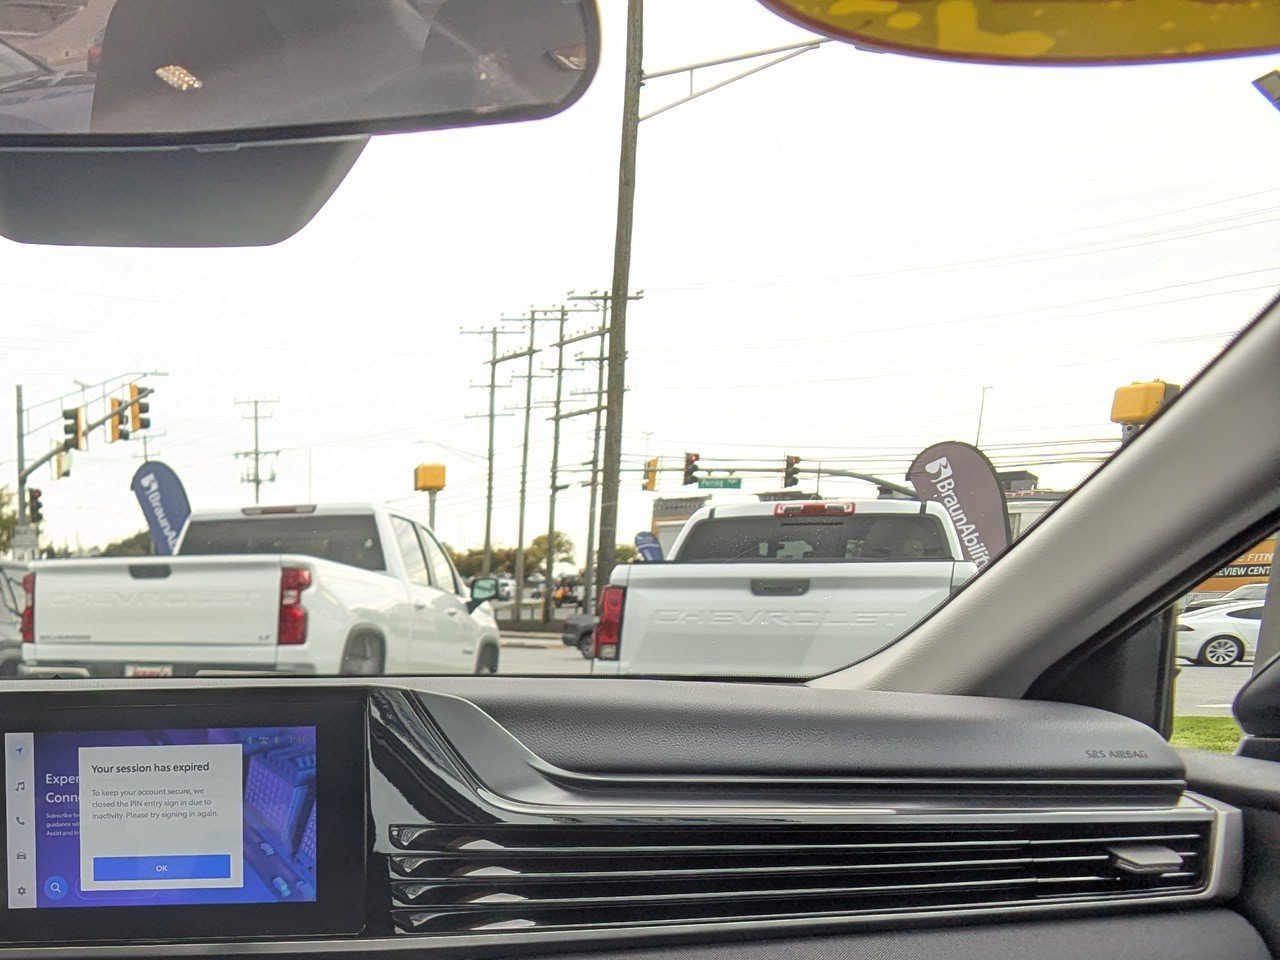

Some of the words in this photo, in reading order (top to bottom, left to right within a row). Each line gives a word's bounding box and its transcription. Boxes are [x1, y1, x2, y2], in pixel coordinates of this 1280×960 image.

[49, 591, 263, 608] CHEVROLET
[653, 608, 908, 627] CHEVROLET
[1085, 749, 1107, 759] SRS
[1109, 750, 1148, 759] AIRBAG
[91, 764, 114, 774] Your
[116, 763, 152, 773] session
[154, 762, 171, 772] has
[173, 761, 210, 774] expired
[45, 792, 80, 804] Conn
[102, 789, 119, 798] keep
[120, 789, 136, 798] your
[137, 788, 166, 796] account
[167, 788, 192, 796] secure,
[193, 787, 205, 795] we
[116, 800, 129, 808] the
[130, 800, 143, 808] PIN
[144, 800, 162, 809] entry
[164, 799, 179, 809] sign
[180, 799, 187, 807] in
[188, 799, 203, 807] due
[92, 812, 125, 821] inactivity.
[125, 811, 150, 820] Please
[150, 812, 160, 821] try
[161, 810, 188, 820] signing
[188, 810, 196, 818] in
[197, 810, 219, 819] again.
